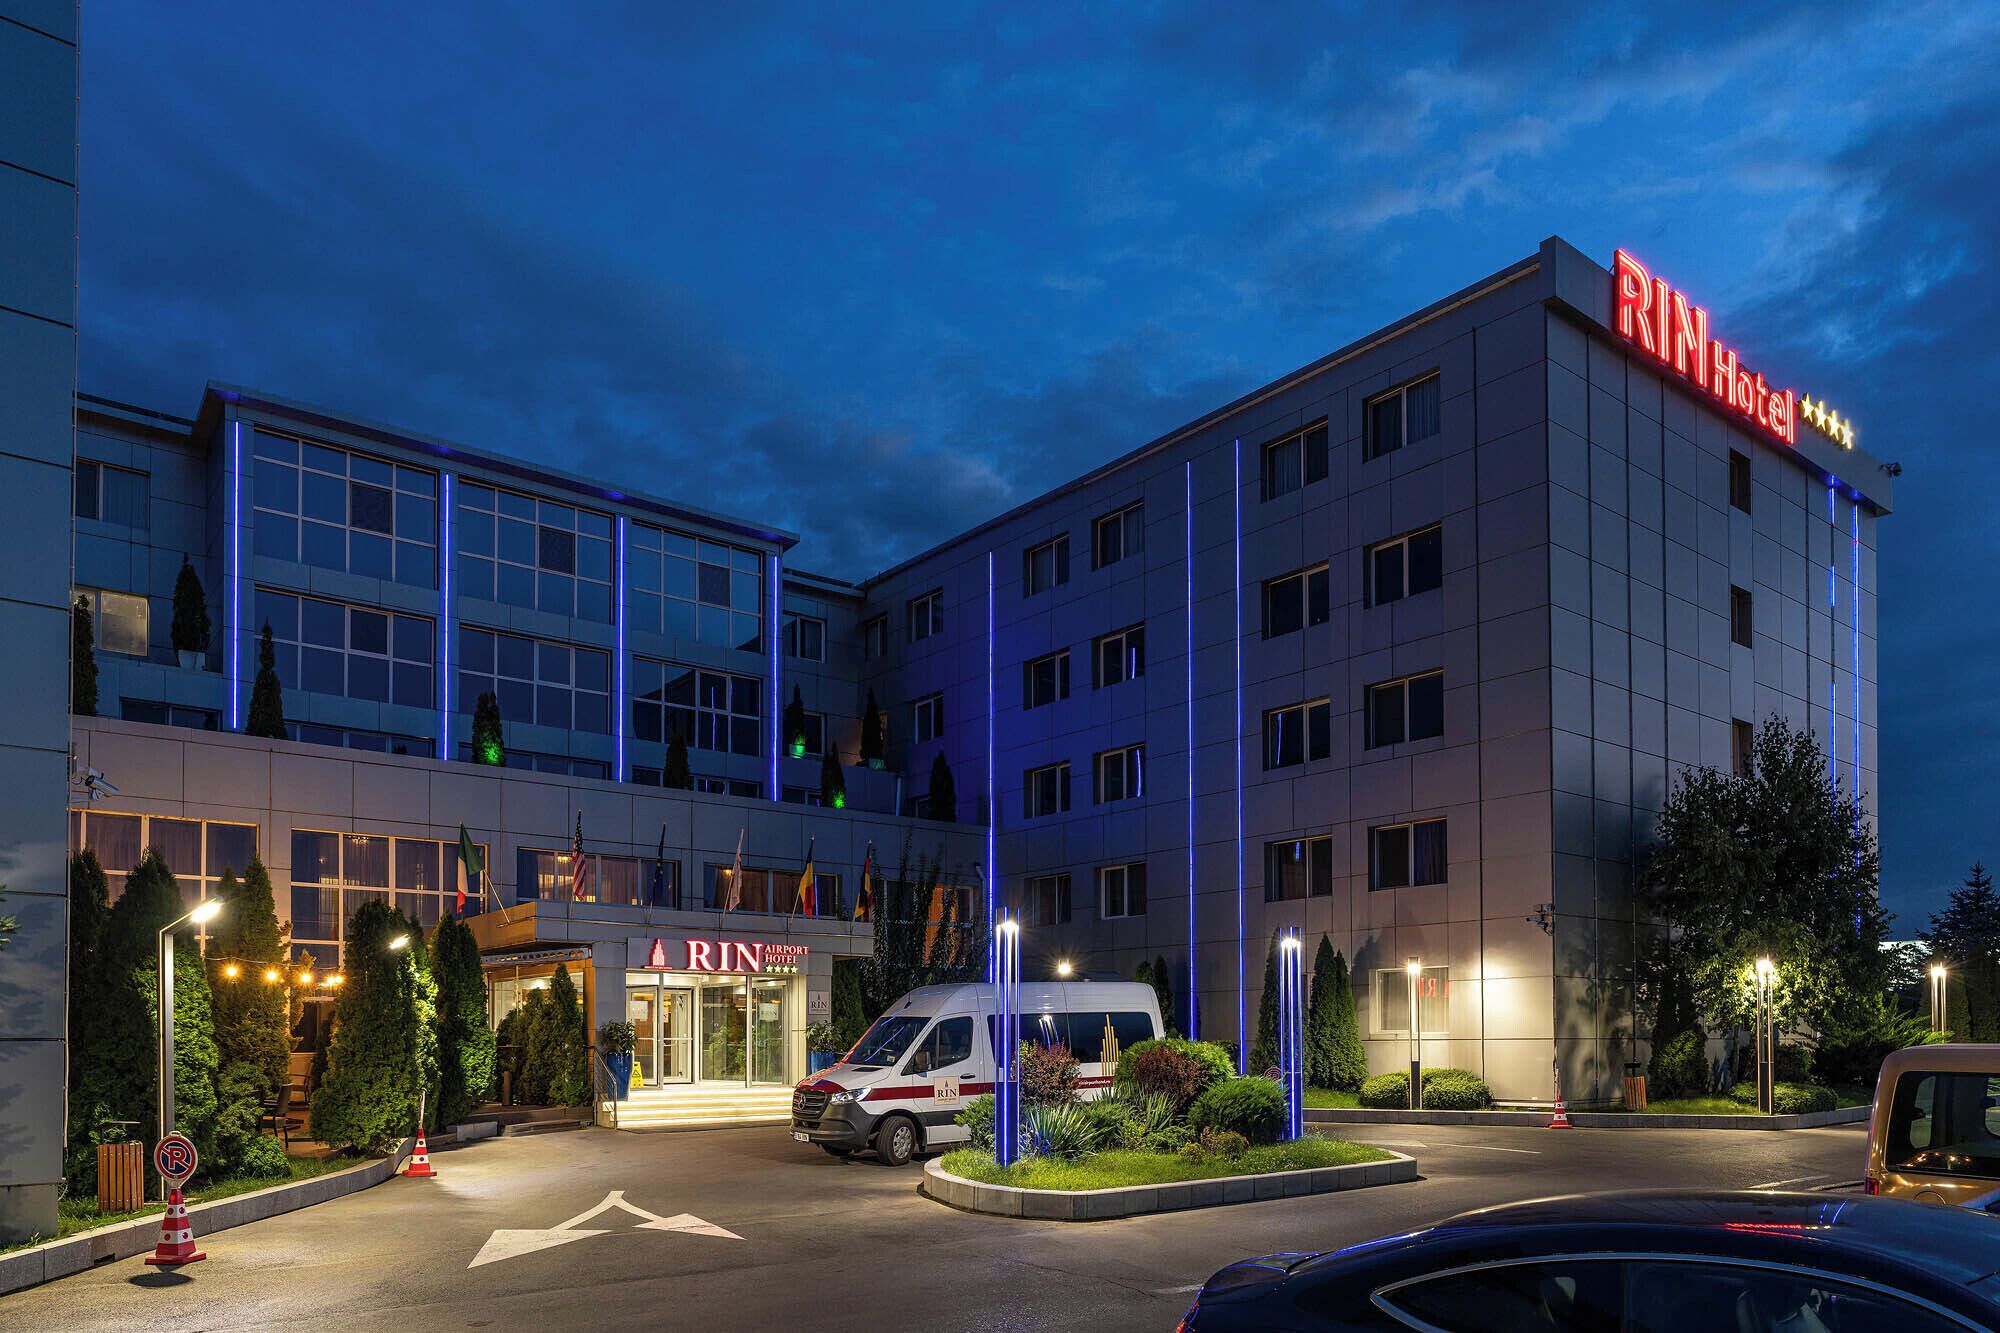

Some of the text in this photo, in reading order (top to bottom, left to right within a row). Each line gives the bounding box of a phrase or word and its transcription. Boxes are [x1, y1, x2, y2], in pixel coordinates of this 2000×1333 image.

[1613, 248, 1795, 444] RIN Hotel
[764, 944, 809, 955] AIRPORT
[686, 939, 763, 972] RIN
[765, 953, 797, 964] HOTEL
[811, 1001, 828, 1009] RIN
[937, 1088, 957, 1098] RIN
